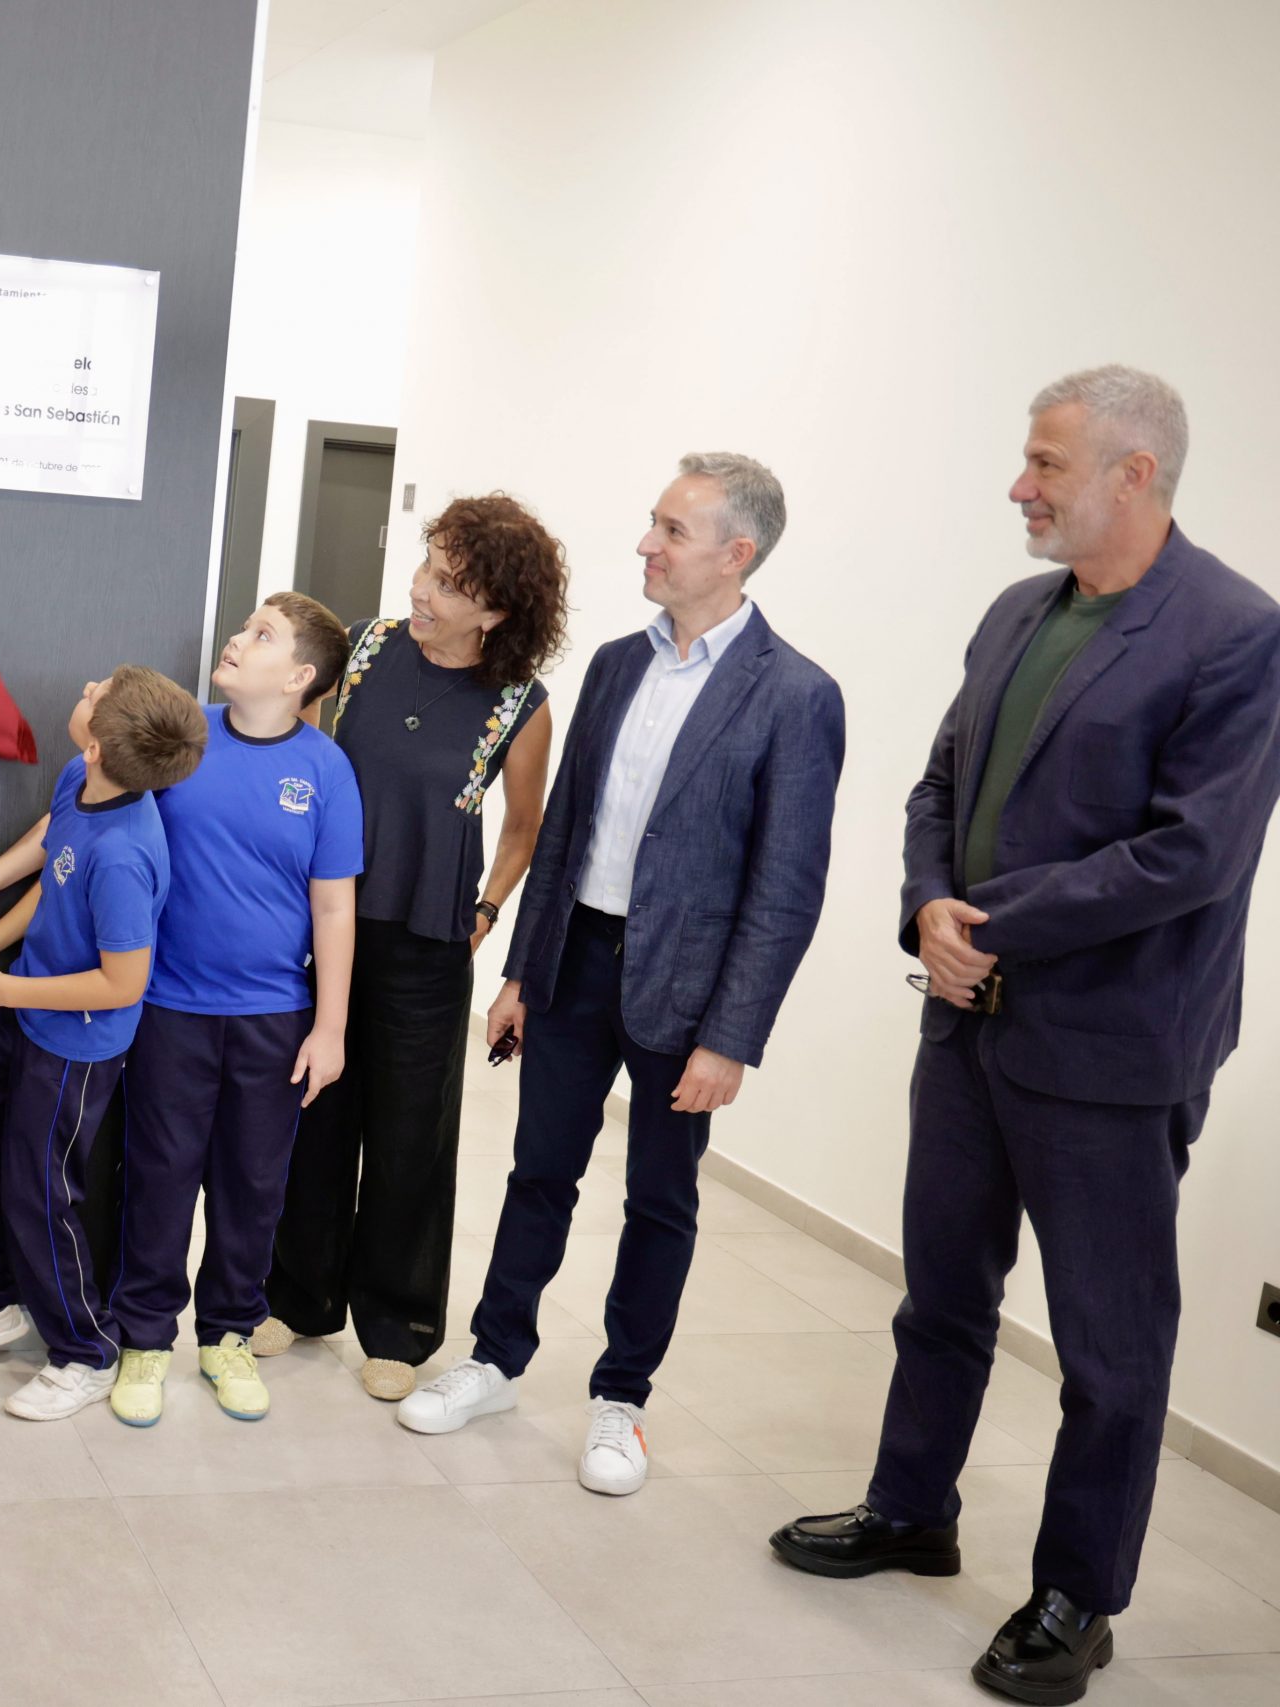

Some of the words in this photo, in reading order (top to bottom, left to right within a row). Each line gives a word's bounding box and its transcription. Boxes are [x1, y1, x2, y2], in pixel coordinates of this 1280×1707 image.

[14, 403, 42, 420] San
[47, 406, 120, 427] Sebastián
[65, 463, 79, 472] de
